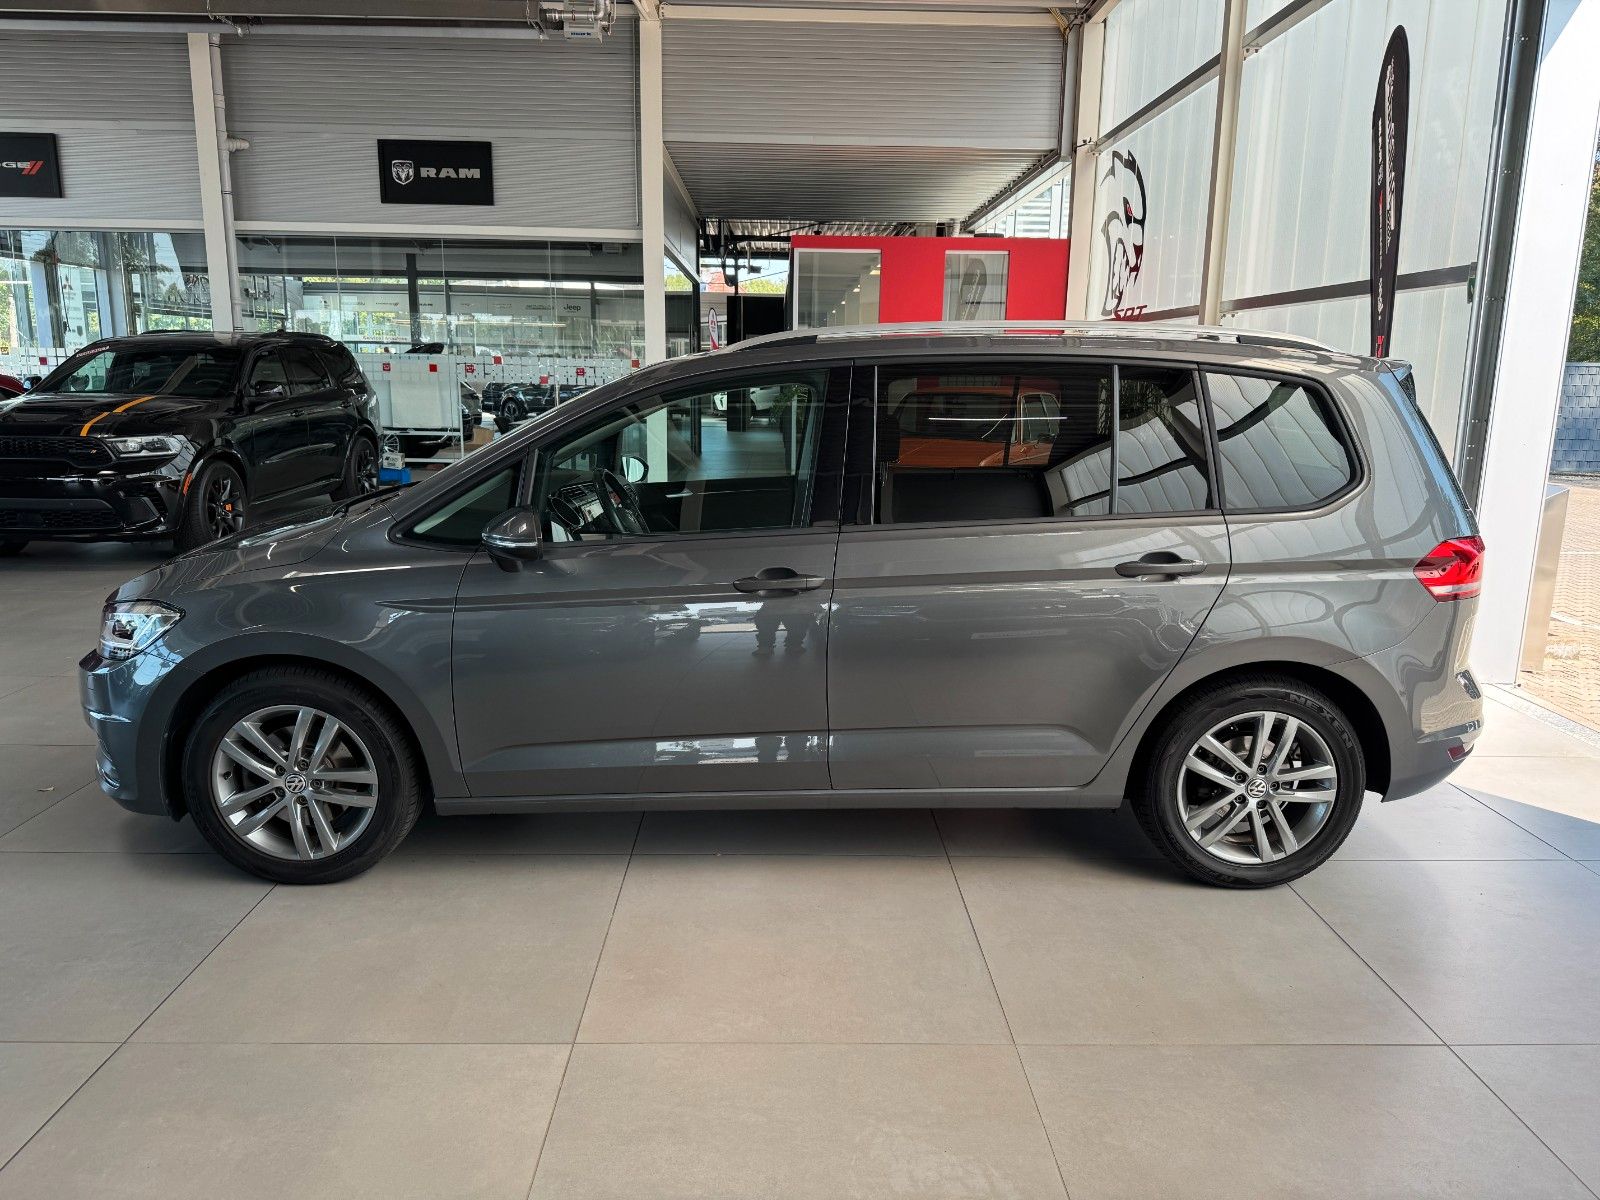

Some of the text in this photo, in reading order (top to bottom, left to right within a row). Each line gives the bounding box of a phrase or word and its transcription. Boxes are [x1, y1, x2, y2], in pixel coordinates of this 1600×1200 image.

[0, 161, 31, 169] GE
[420, 167, 481, 179] RAM
[563, 303, 582, 312] Jeep
[1289, 693, 1353, 749] NEXEN
